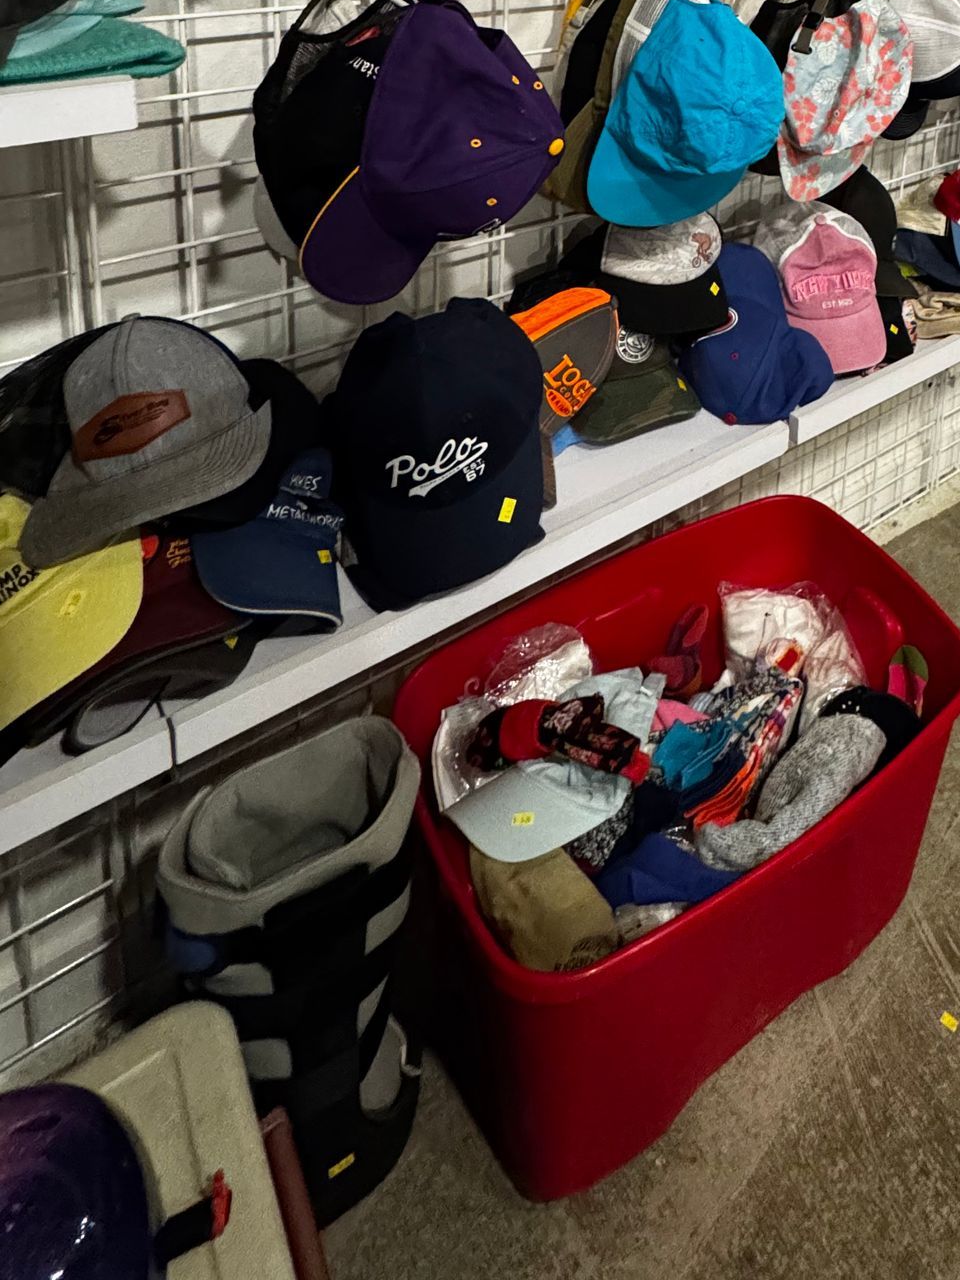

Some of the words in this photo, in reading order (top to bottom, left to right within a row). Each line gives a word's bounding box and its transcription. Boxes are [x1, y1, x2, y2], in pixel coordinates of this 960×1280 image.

[792, 274, 828, 303] NEW
[385, 436, 479, 488] Polo
[465, 463, 486, 482] 67
